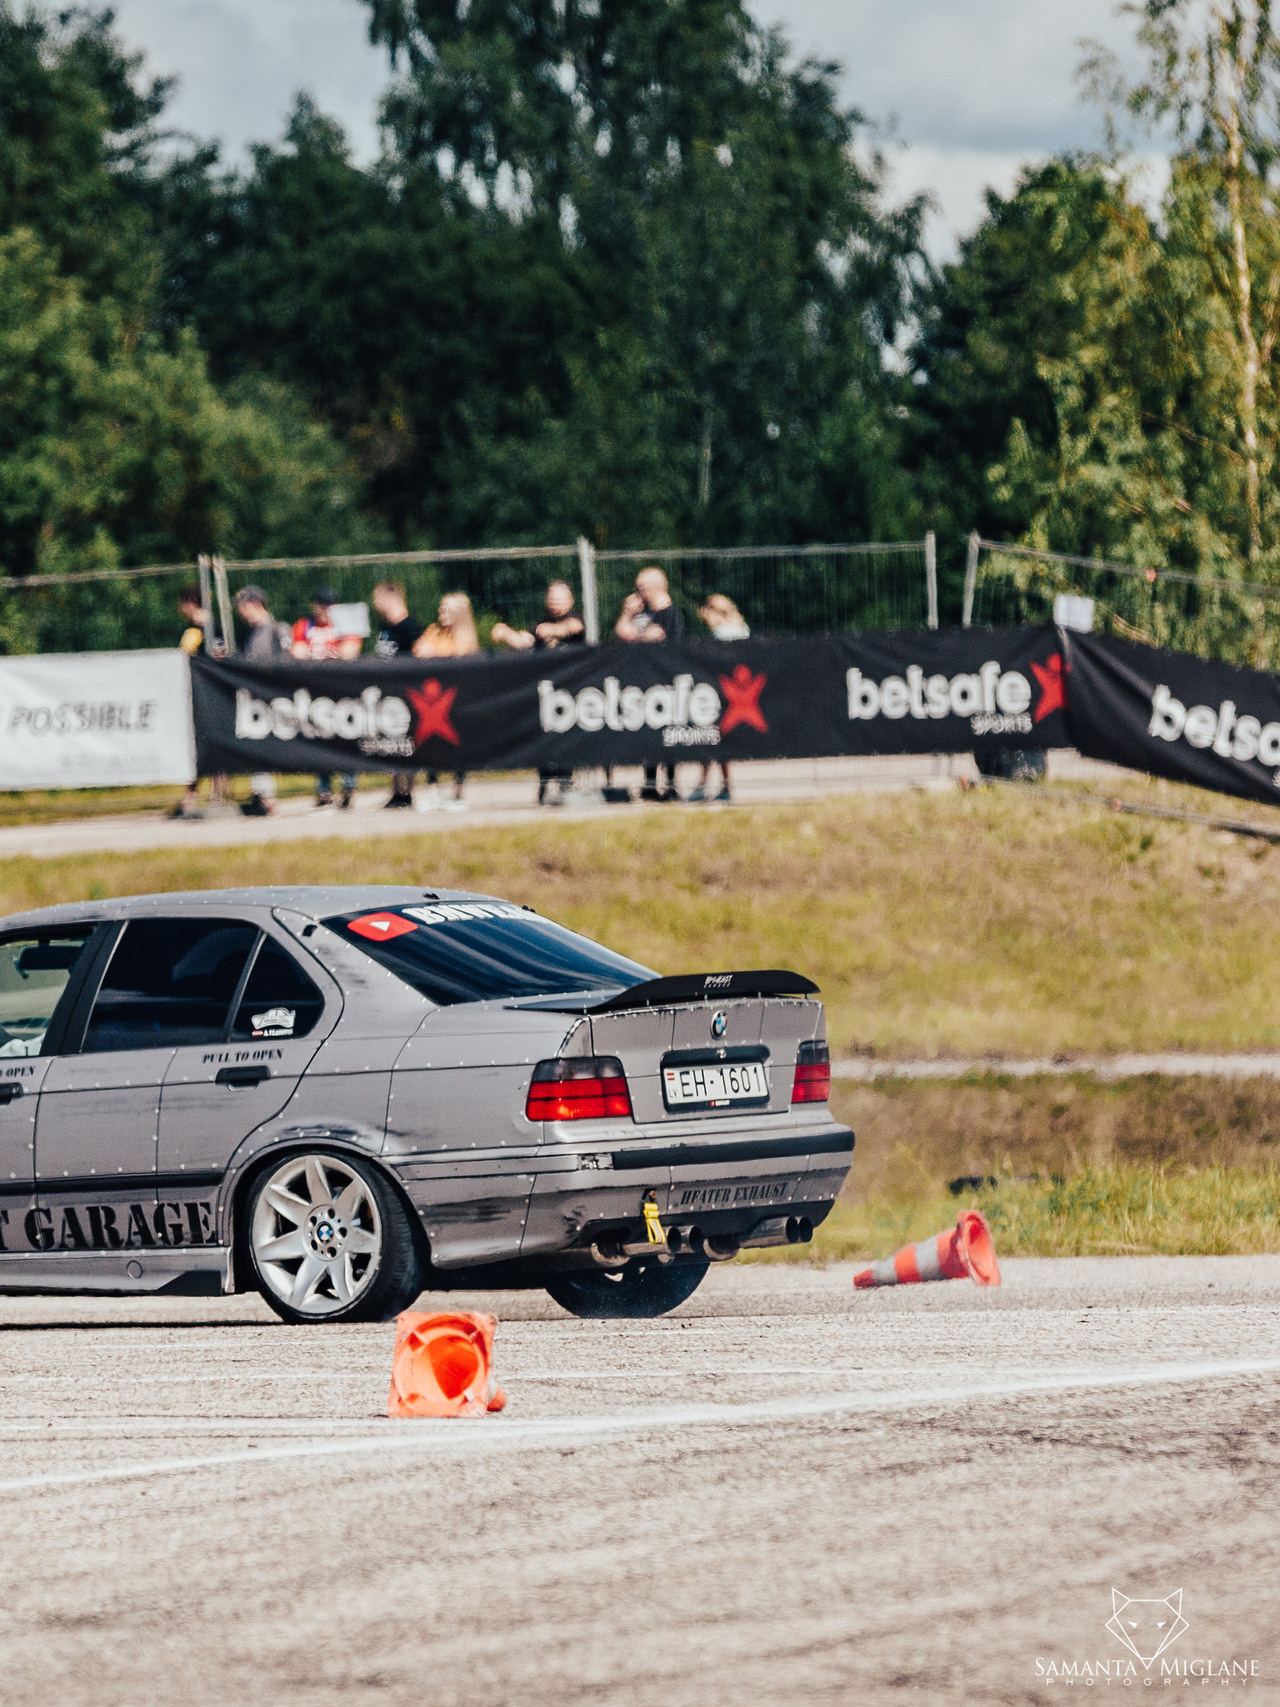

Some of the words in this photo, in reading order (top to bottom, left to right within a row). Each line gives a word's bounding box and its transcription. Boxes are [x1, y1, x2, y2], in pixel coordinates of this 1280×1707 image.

[537, 673, 721, 733] betsafe
[846, 660, 1032, 720] betsafe
[7, 698, 158, 738] POSSIBLE
[234, 685, 412, 741] betsafe
[970, 711, 1033, 735] SPORTS
[5, 1065, 36, 1078] OPEN
[202, 1052, 231, 1063] PULL
[235, 1051, 250, 1062] TO
[252, 1048, 285, 1061] OPEN
[669, 1089, 677, 1098] LV
[680, 1066, 761, 1098] EH-1601
[680, 1187, 731, 1205] HEATER
[733, 1182, 790, 1201] EXHAUST
[23, 1201, 218, 1252] GARAGE
